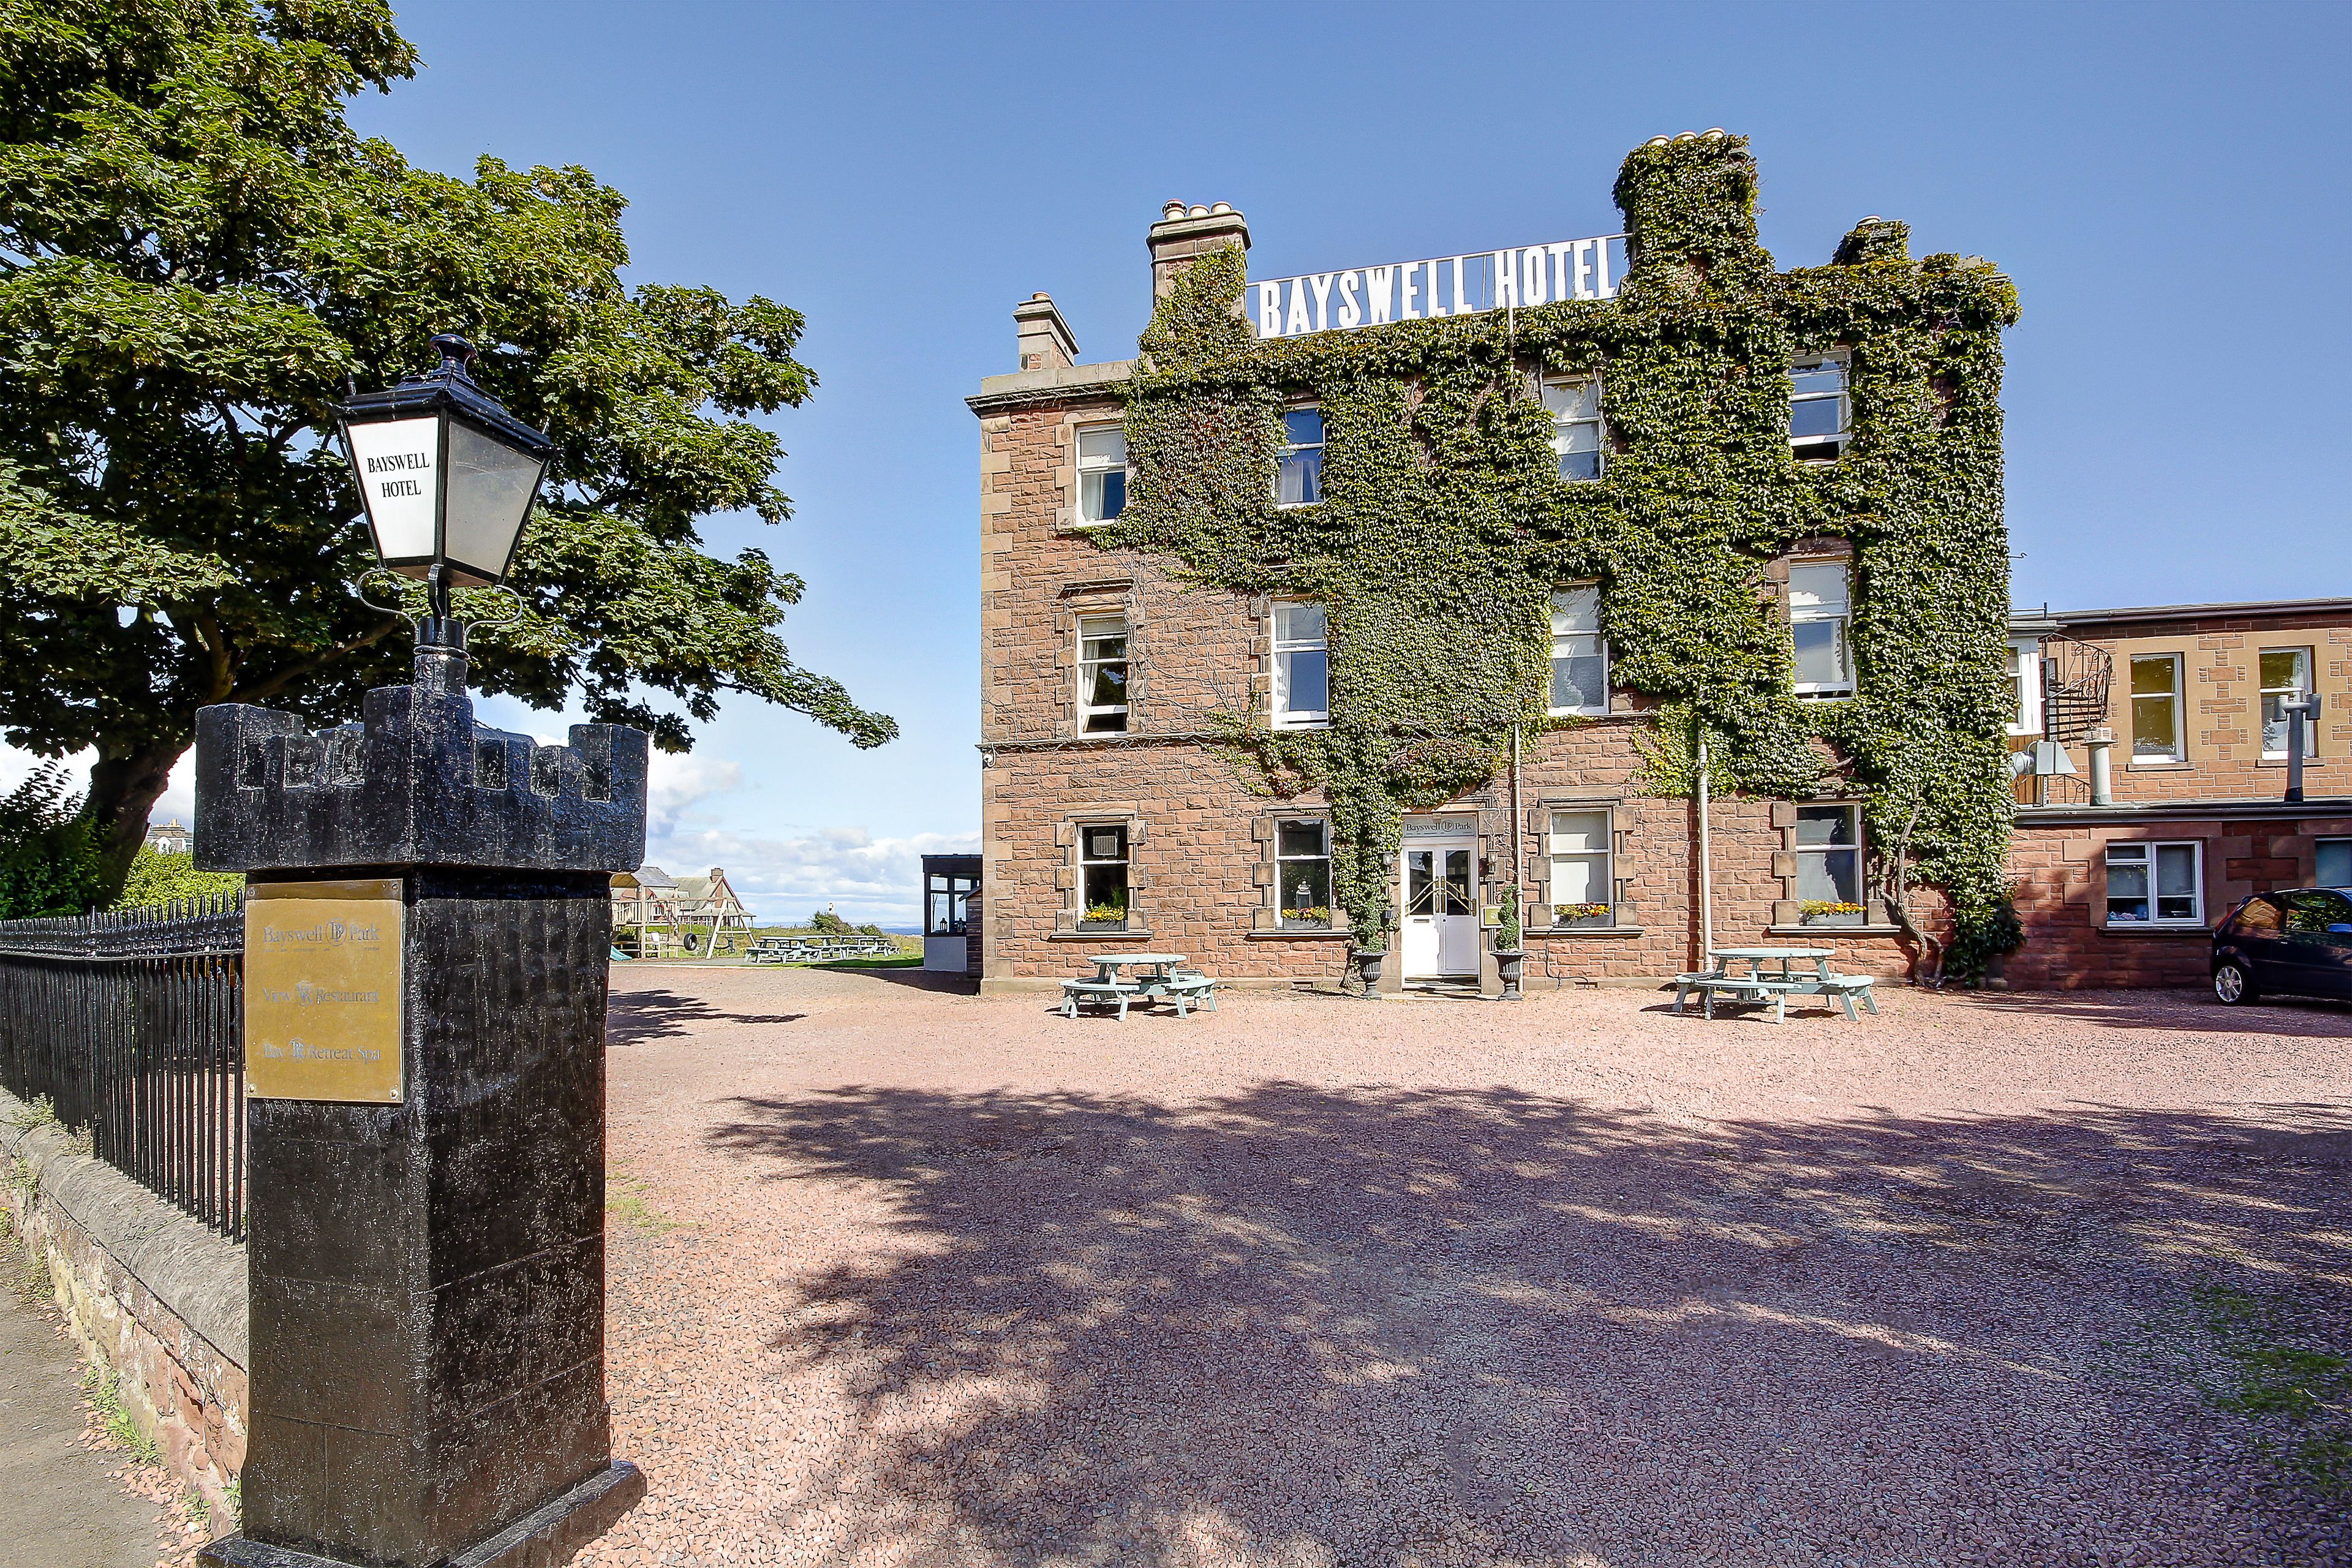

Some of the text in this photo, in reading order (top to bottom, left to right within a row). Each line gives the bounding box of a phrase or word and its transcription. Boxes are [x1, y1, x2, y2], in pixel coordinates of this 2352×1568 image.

[1259, 237, 1617, 339] BAYSWELL HOTEL
[367, 452, 430, 473] BAYSWELL
[381, 480, 421, 498] HOTEL
[1406, 823, 1441, 832] Bayswell
[263, 924, 324, 946] Bayswell
[350, 923, 380, 941] Park
[262, 987, 292, 1002] View
[315, 987, 380, 1003] Restaurant
[263, 1042, 284, 1062] Bay
[308, 1044, 353, 1060] Retreat
[357, 1045, 381, 1065] Spa
